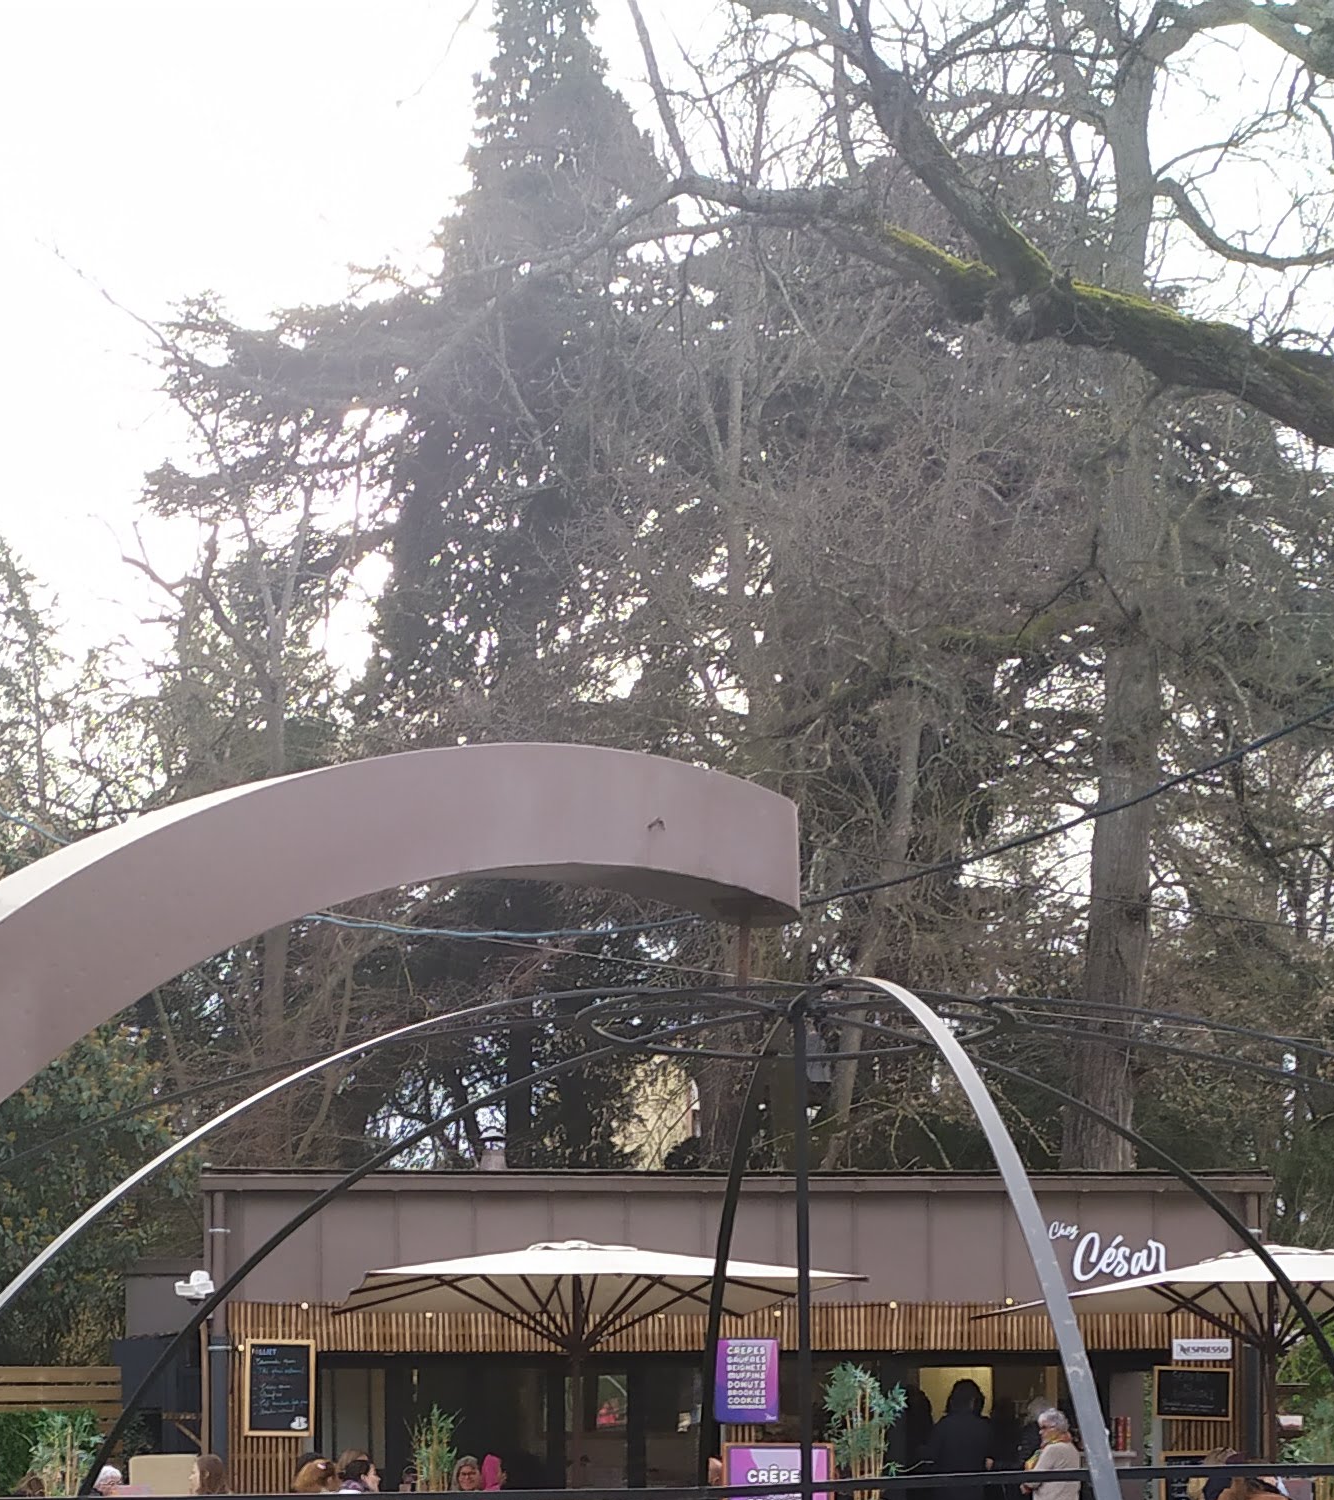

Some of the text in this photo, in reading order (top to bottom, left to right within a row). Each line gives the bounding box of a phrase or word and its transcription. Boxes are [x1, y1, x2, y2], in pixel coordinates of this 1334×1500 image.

[1048, 1221, 1079, 1239] Chez
[1072, 1232, 1166, 1281] César
[727, 1343, 766, 1355] CRÊPES
[1177, 1343, 1229, 1356] NESPRESSO
[747, 1465, 801, 1483] CRÊPE
